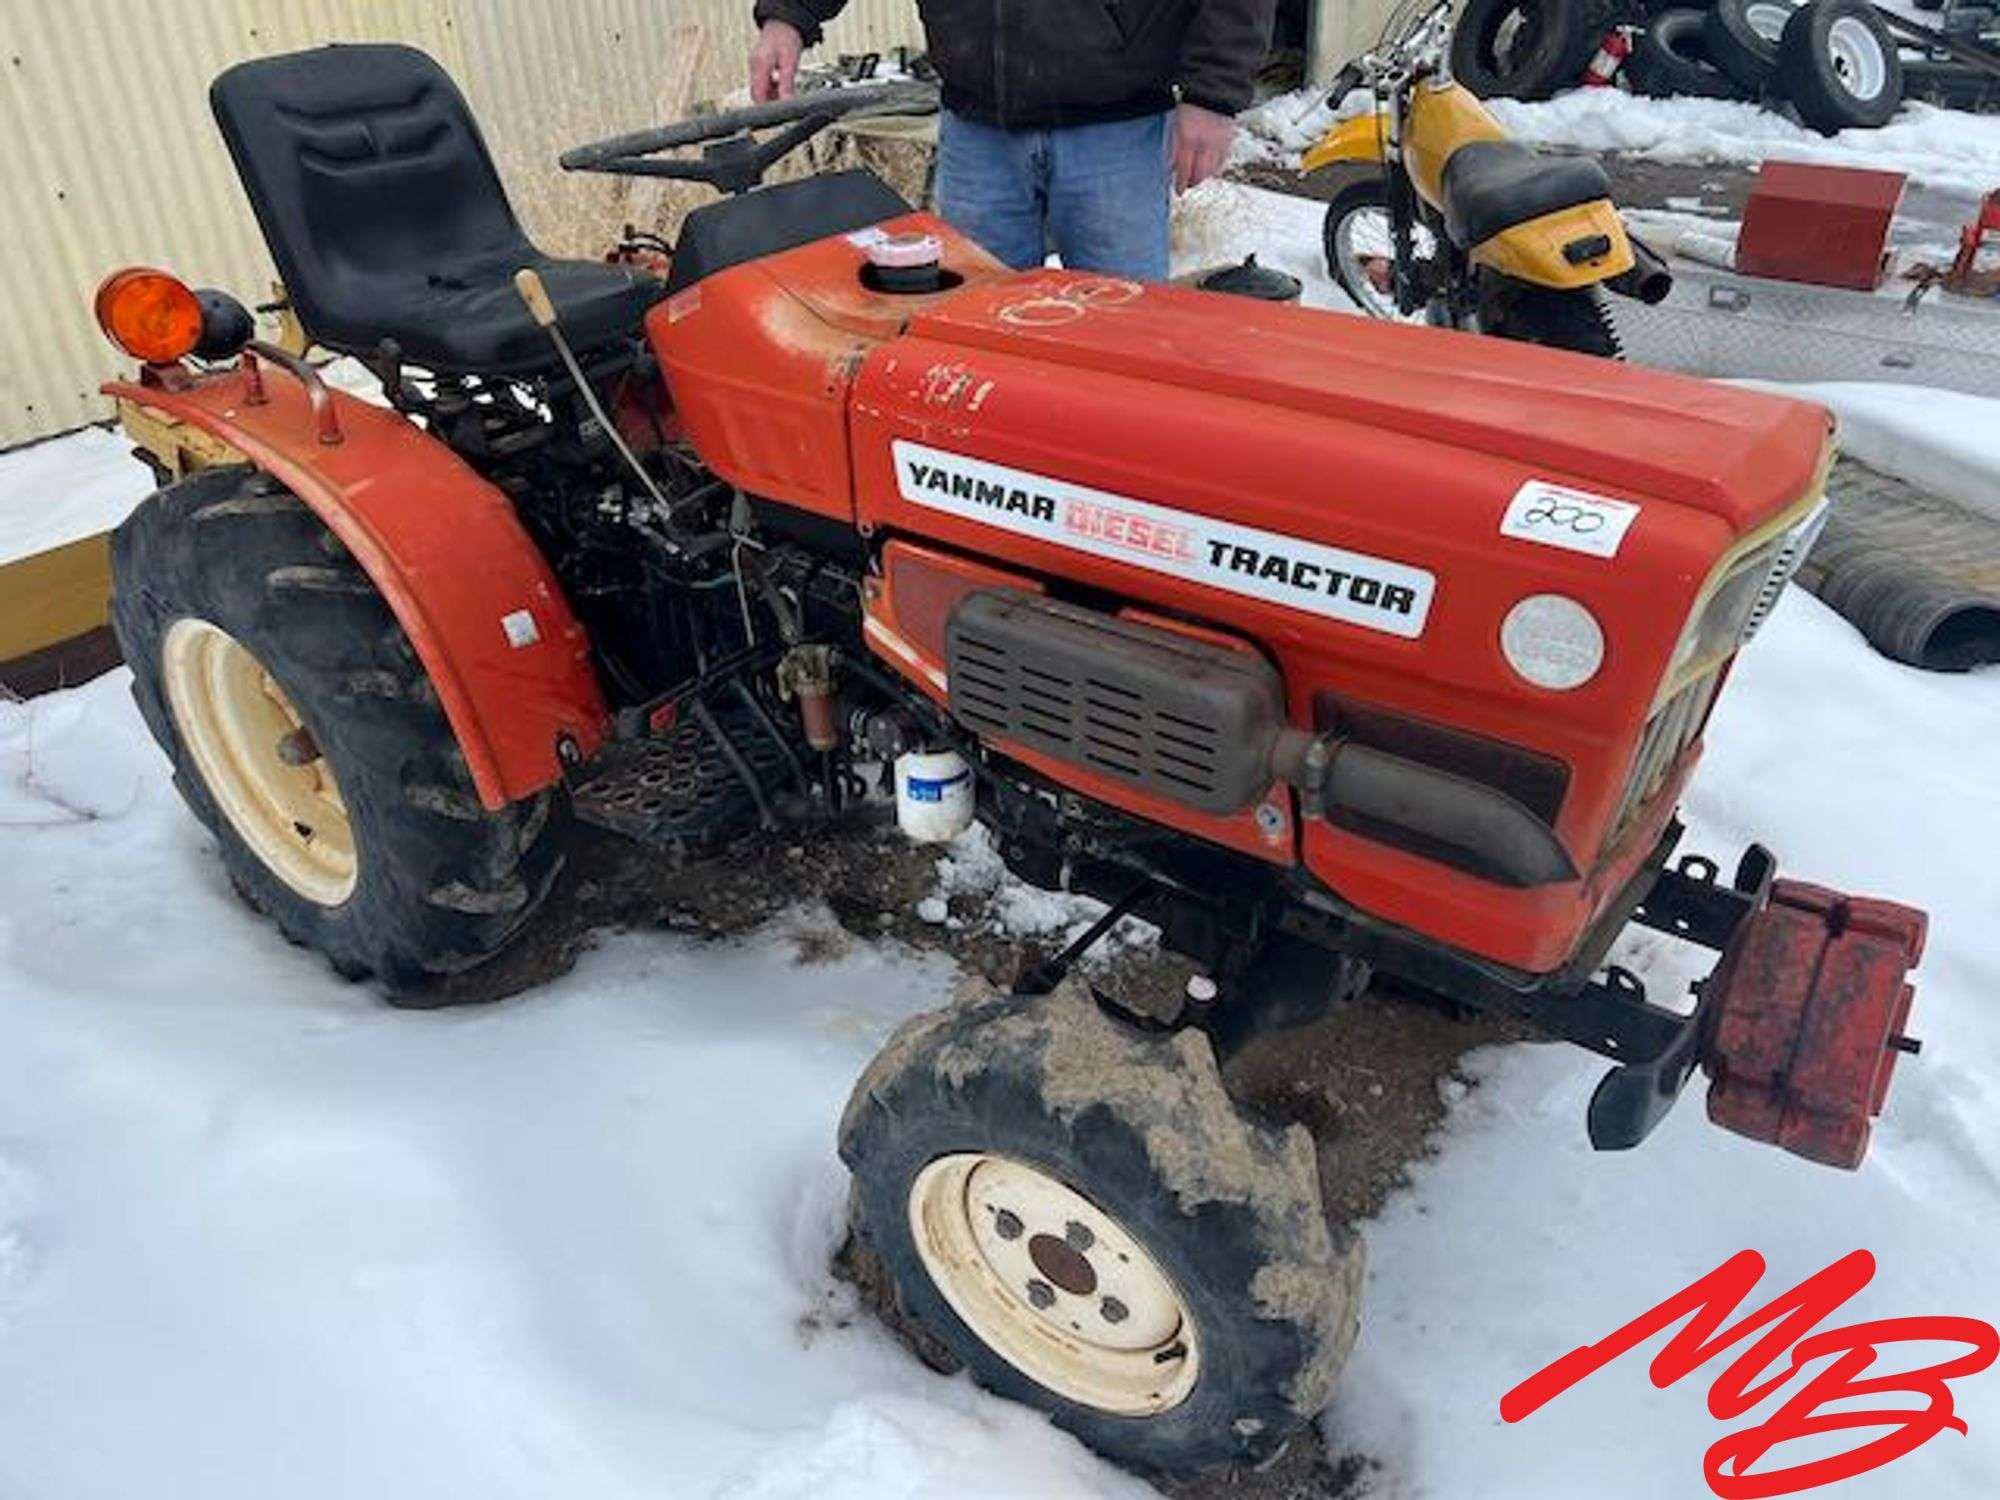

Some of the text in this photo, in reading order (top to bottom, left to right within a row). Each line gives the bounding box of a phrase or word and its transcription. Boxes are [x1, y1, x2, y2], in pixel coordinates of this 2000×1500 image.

[908, 461, 1417, 615] YANMAR DIESEL TRACTOR
[1524, 497, 1604, 533] 200
